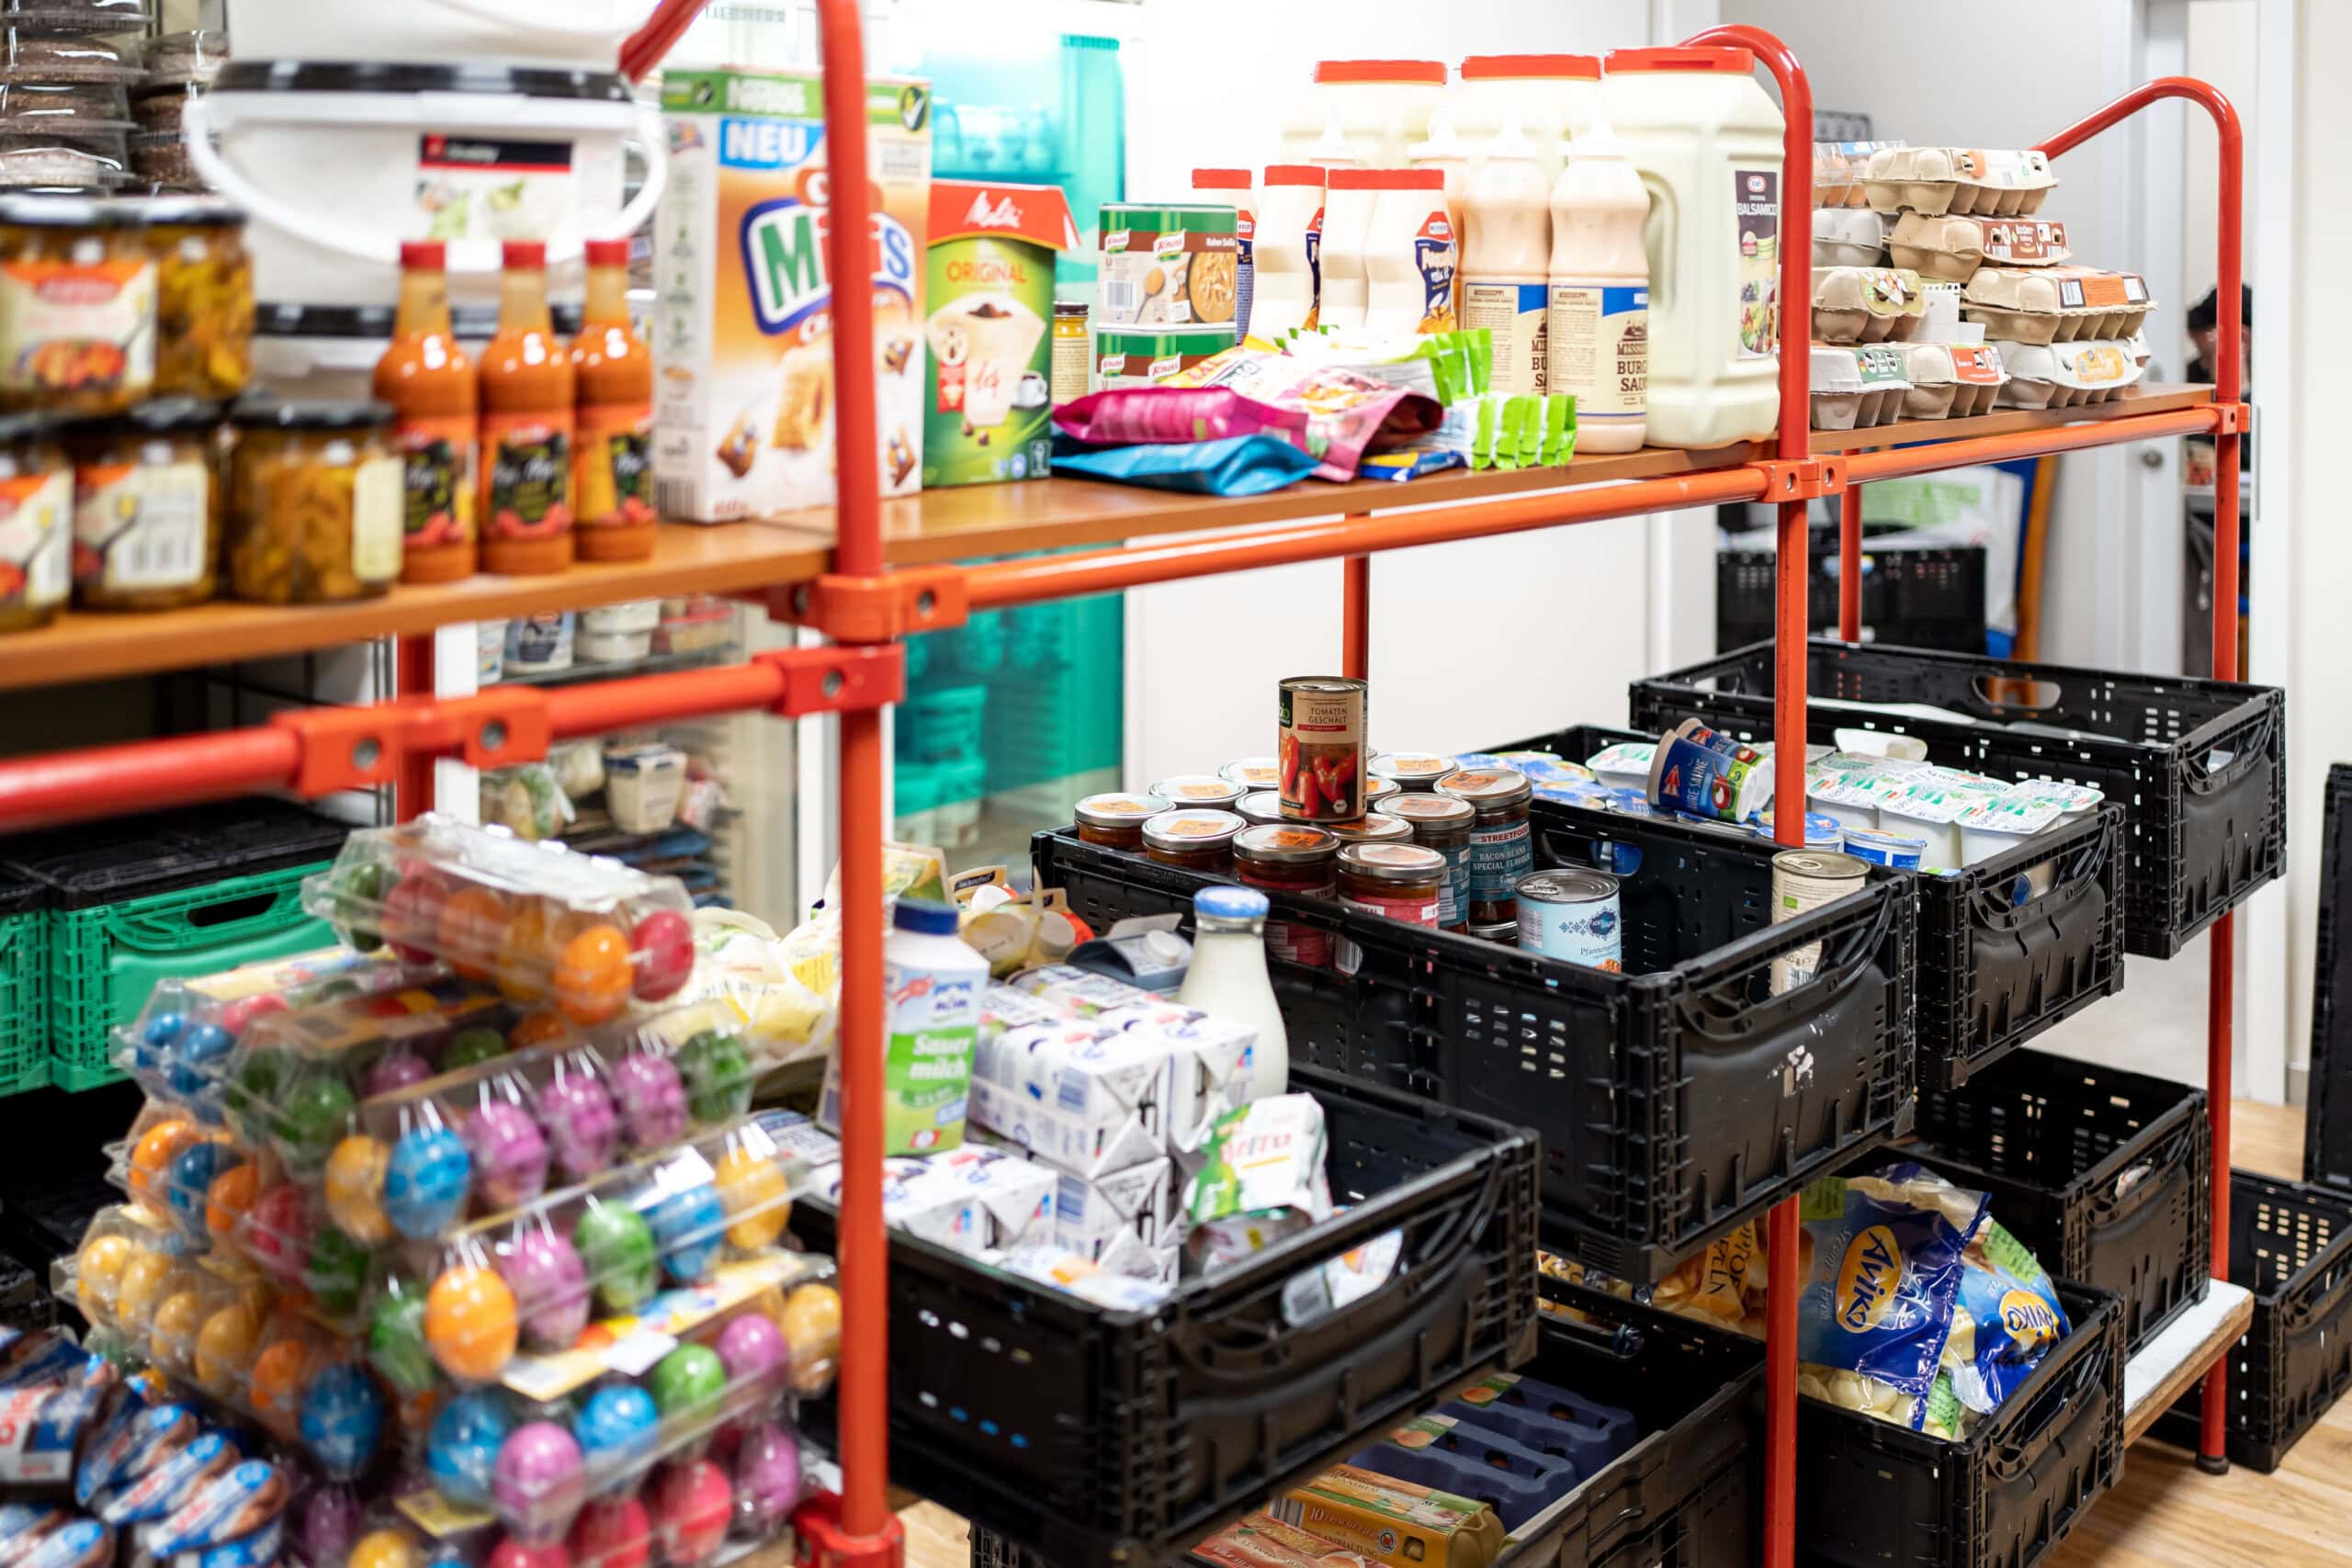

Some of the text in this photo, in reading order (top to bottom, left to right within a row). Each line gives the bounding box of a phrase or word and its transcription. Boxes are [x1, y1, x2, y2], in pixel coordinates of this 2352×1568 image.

[726, 122, 809, 164] NEU
[945, 260, 1028, 284] ORIGINAL
[1310, 707, 1347, 716] TOMATEN
[1473, 863, 1504, 871] SPECIAL
[1479, 852, 1504, 861] BACON
[912, 1033, 971, 1056] Sauer
[909, 1056, 967, 1080] milch
